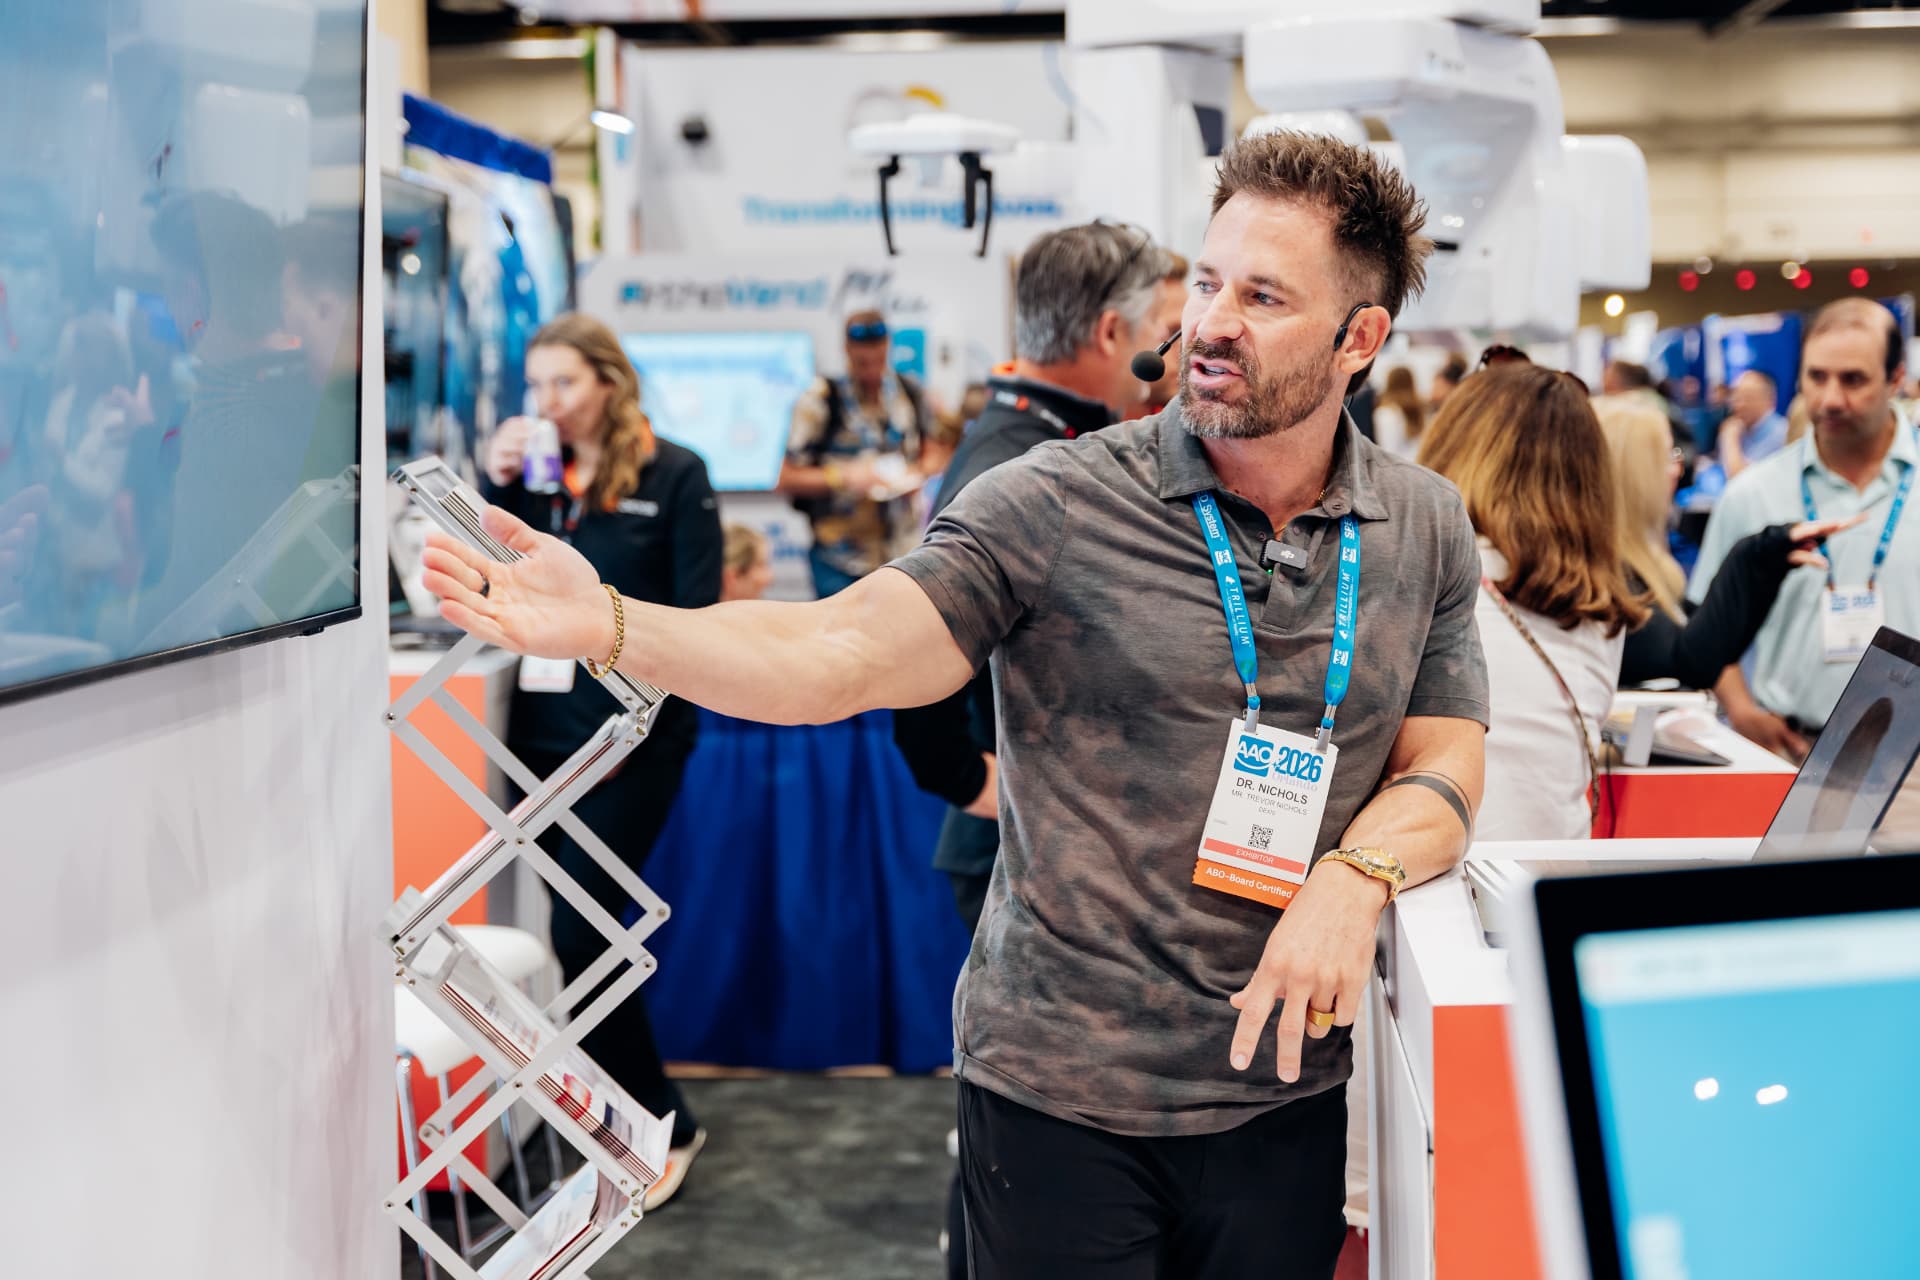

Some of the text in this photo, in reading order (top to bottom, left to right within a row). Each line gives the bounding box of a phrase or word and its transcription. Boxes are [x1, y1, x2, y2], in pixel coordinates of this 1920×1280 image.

[1339, 572, 1350, 626] TRILLIUM
[1230, 587, 1249, 645] TRILLIUM
[1238, 741, 1273, 764] AAO
[1275, 747, 1324, 782] 2026
[1237, 777, 1308, 804] DR. NICHOLS
[1277, 802, 1307, 816] NICHOLS
[1236, 849, 1274, 864] EXHIBITOR
[1256, 882, 1292, 898] Certified
